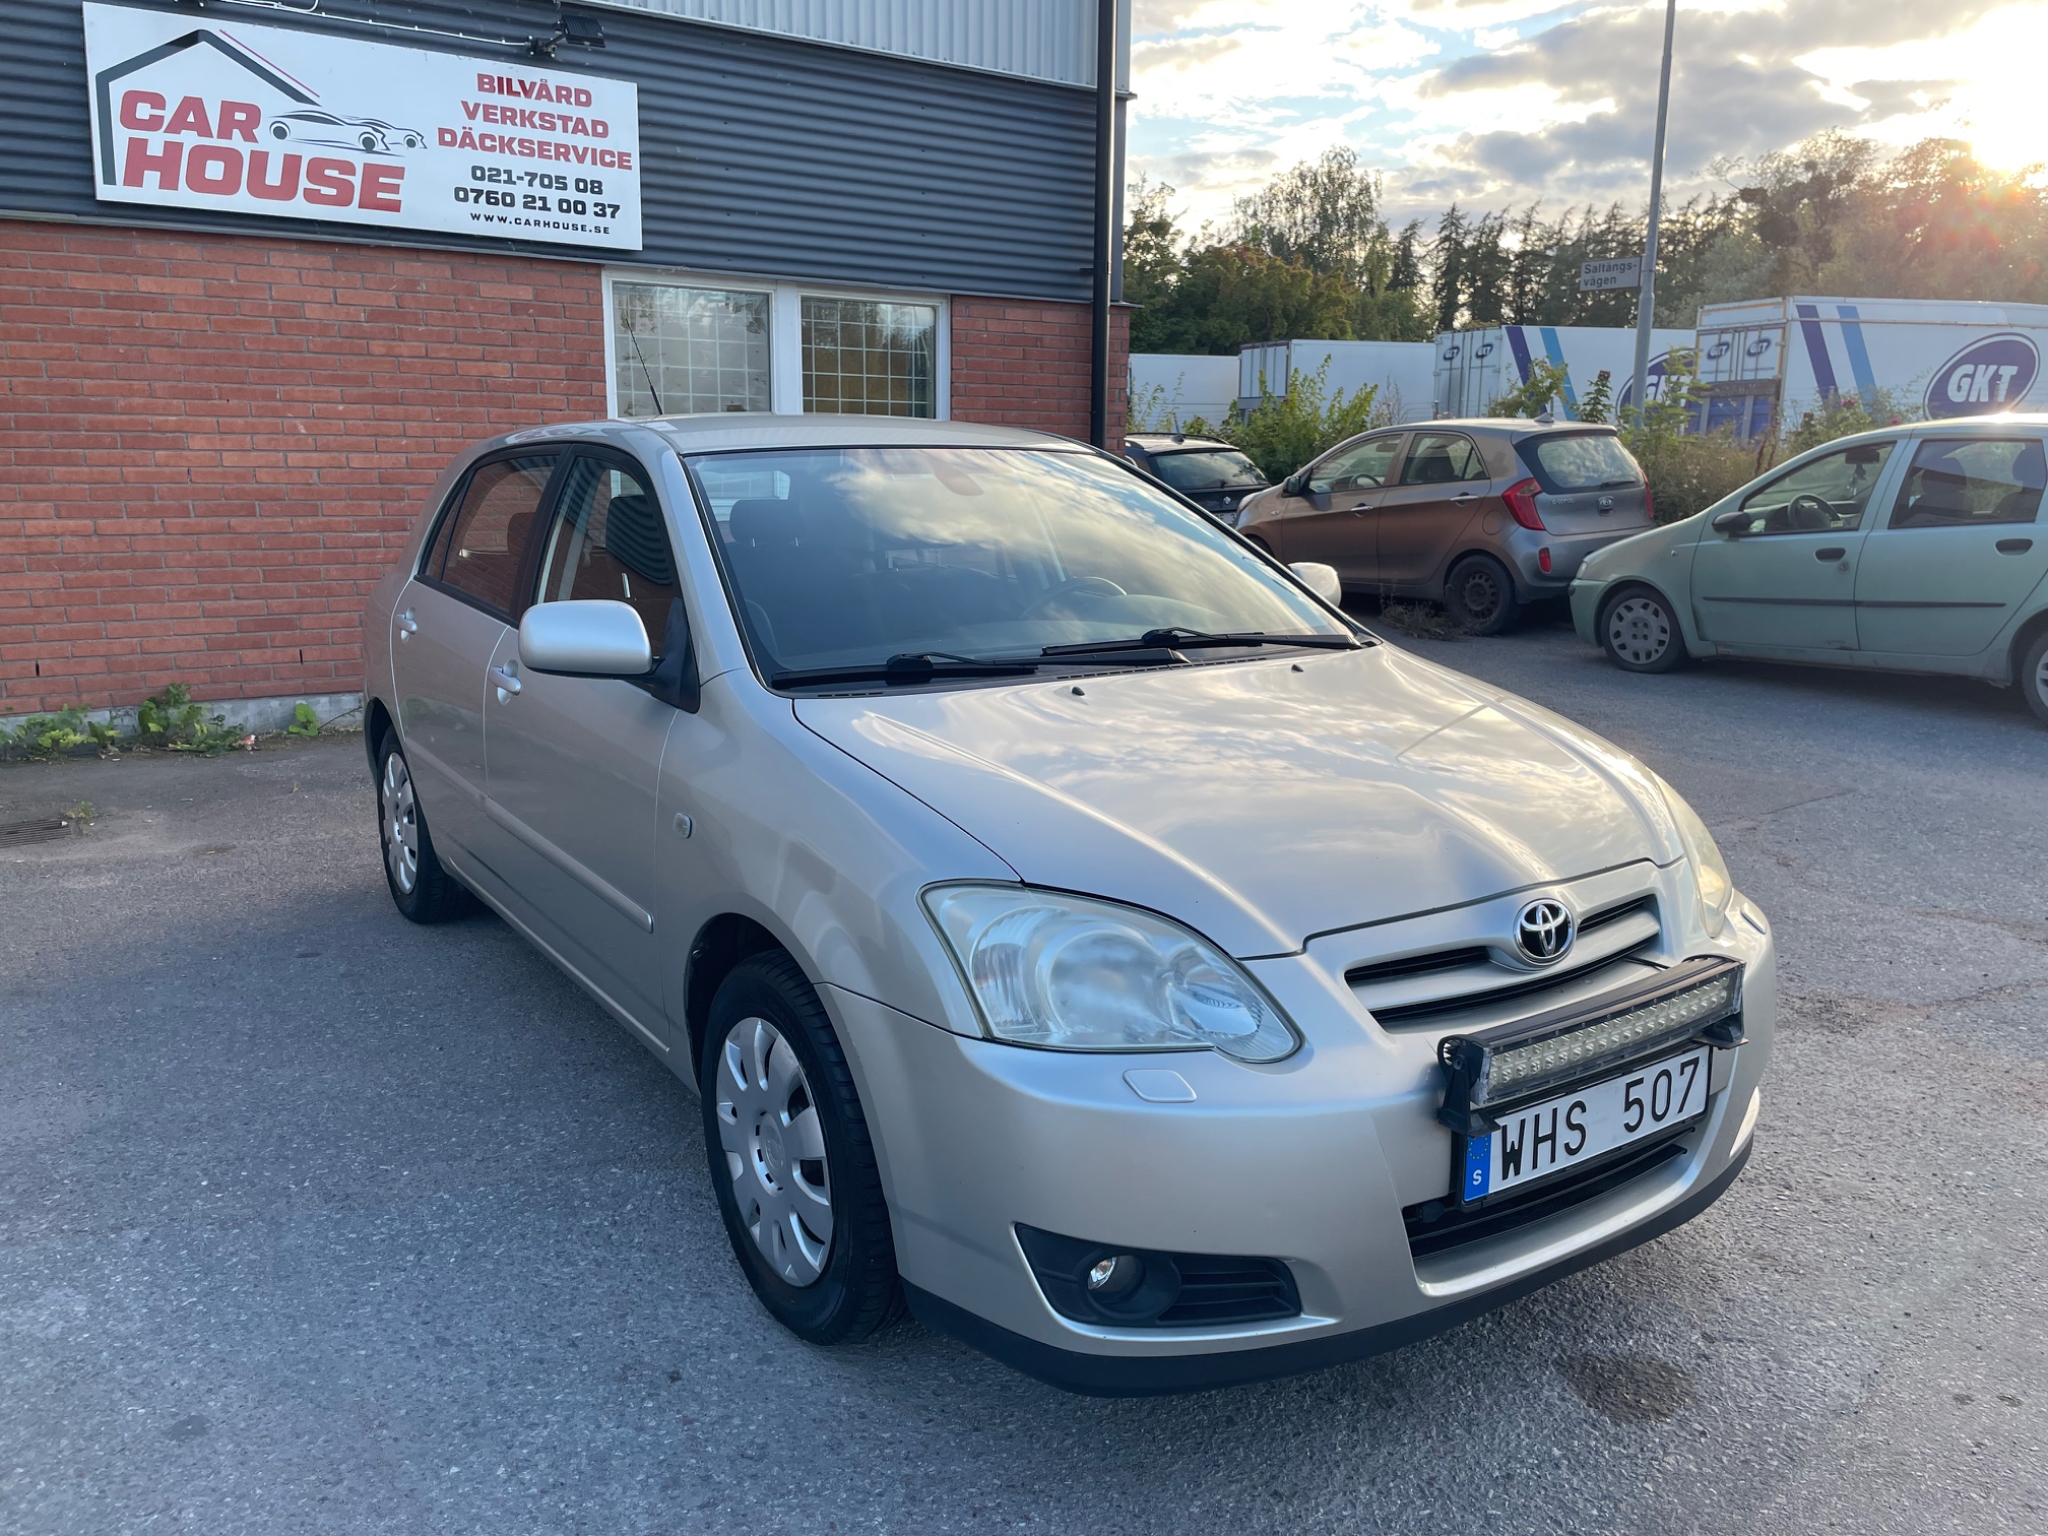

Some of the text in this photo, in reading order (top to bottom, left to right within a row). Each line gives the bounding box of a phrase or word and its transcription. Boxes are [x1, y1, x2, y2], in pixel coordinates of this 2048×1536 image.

[477, 73, 592, 108] BILVÅRD
[119, 89, 262, 144] CAR
[460, 100, 609, 138] VERKSTAD
[437, 126, 633, 171] DÄCKSERVICE
[122, 136, 406, 213] HOUSE
[471, 165, 604, 195] 021-705 08
[454, 186, 621, 219] 0760 21 00 37
[470, 212, 610, 235] WWW.CARHOUSE.SE
[1583, 275, 1617, 288] vägen
[1584, 261, 1638, 275] Saltängs-
[1947, 363, 2019, 403] GKT
[1501, 1056, 1700, 1181] WHS 507
[1472, 1169, 1482, 1185] S
